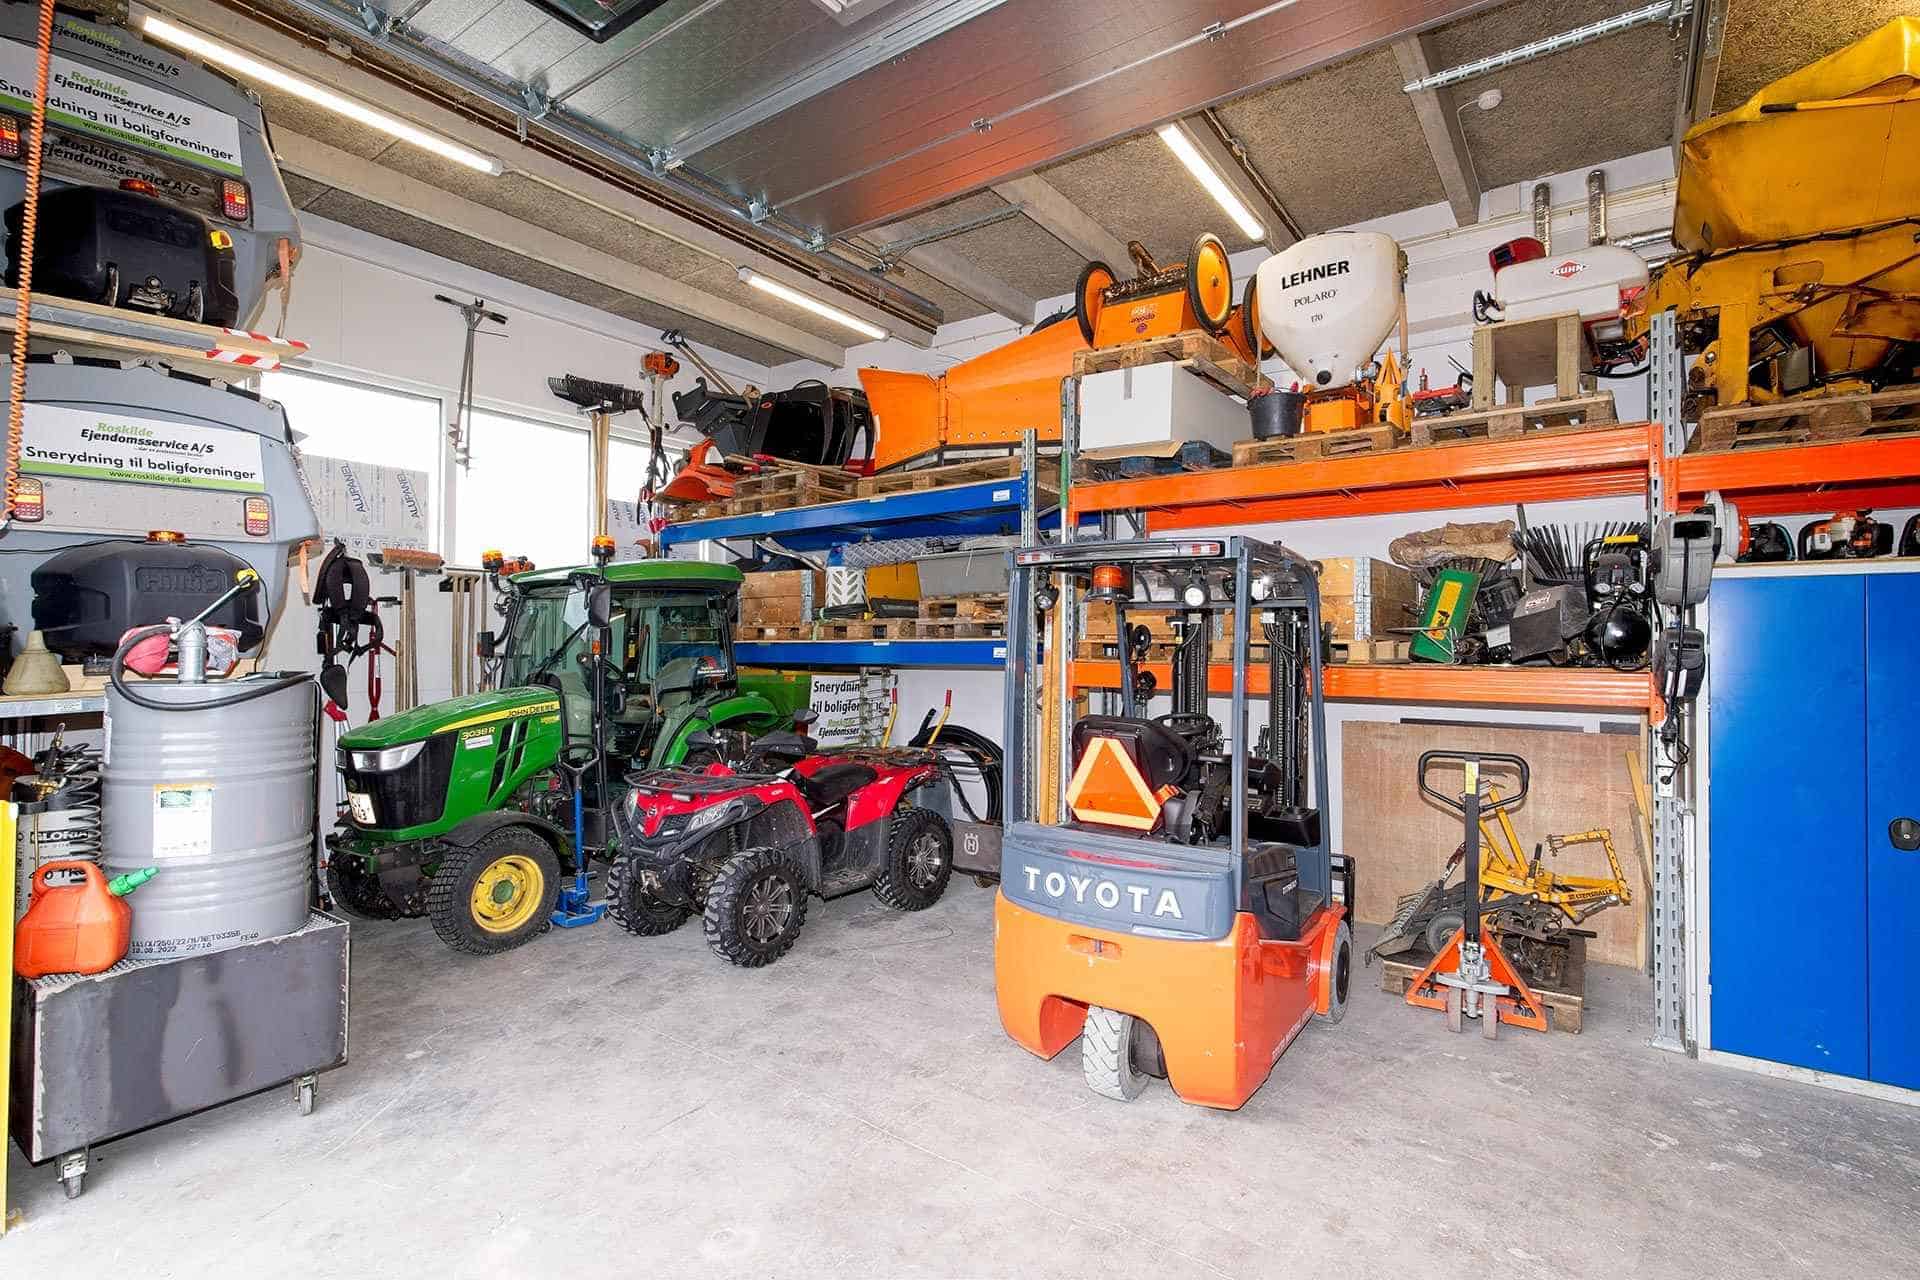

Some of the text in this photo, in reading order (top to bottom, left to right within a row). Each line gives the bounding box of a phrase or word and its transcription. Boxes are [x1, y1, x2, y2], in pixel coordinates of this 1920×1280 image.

[157, 62, 180, 77] A/S
[71, 70, 129, 97] Roskilde
[54, 73, 165, 118] Ejendomsservice
[166, 112, 192, 126] A/S
[0, 79, 98, 121] Snedning
[103, 112, 118, 126] til
[122, 117, 234, 161] boligforeninger
[58, 136, 128, 165] Roskilde
[172, 180, 201, 196] A/S
[1281, 260, 1350, 290] LEHNER
[1294, 288, 1337, 307] POLARO
[80, 428, 189, 451] Ejendomsservice
[191, 442, 215, 454] A/S
[96, 421, 154, 438] Roskilde
[25, 446, 124, 468] Snerydning
[129, 456, 143, 468] til
[147, 457, 257, 481] boligforeninger
[108, 471, 192, 484] www.roskilde-ejd.dk
[341, 463, 367, 513] ALUPANEL
[397, 469, 420, 520] ALUPANEL
[813, 680, 861, 695] Snerydnin
[506, 704, 556, 719] JOHN DEERE
[1023, 866, 1184, 919] TOYOTA
